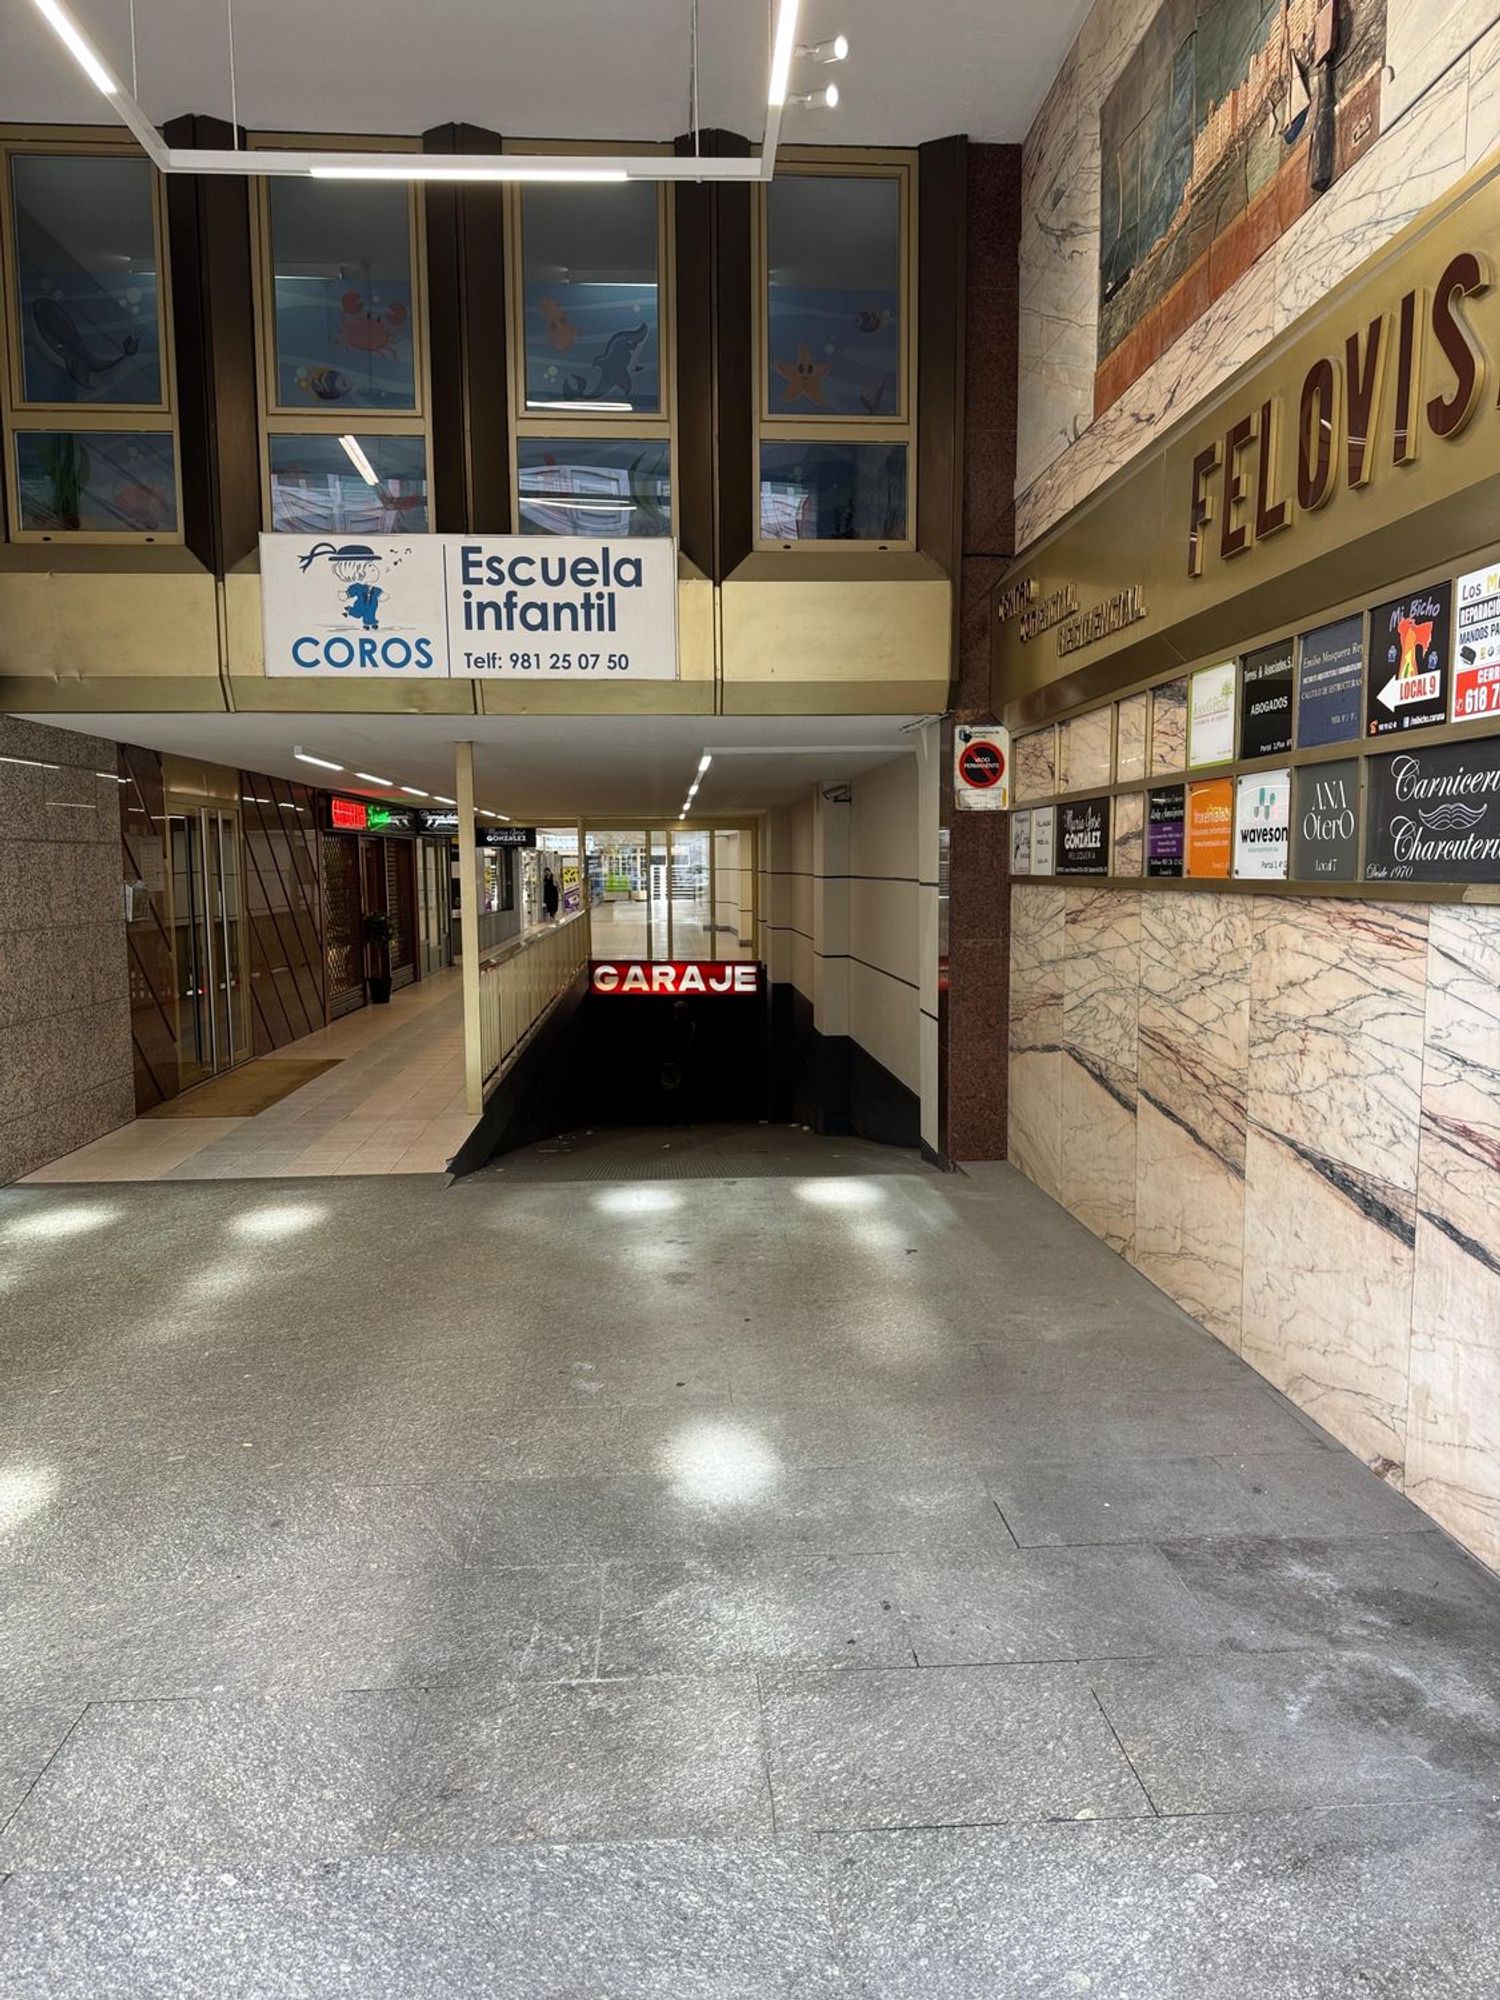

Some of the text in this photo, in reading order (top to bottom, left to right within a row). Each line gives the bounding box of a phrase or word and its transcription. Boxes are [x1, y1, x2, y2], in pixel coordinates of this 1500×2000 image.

[1187, 252, 1500, 578] FELOVIS
[461, 546, 643, 588] Escuela
[1486, 574, 1500, 594] M
[462, 590, 616, 632] infantil
[1389, 596, 1441, 633] Mi Bicho
[1459, 625, 1489, 646] MANDOS
[292, 637, 433, 669] COROS
[464, 652, 629, 670] Telf: 981 25 07 50
[1400, 676, 1436, 700] LOCAL 9
[1250, 696, 1288, 715] ABOGADOS
[1465, 690, 1487, 714] 618
[1311, 780, 1346, 811] ANA
[1240, 826, 1288, 843] waveson
[1389, 866, 1414, 879] 1970
[593, 965, 757, 991] GARAJE
